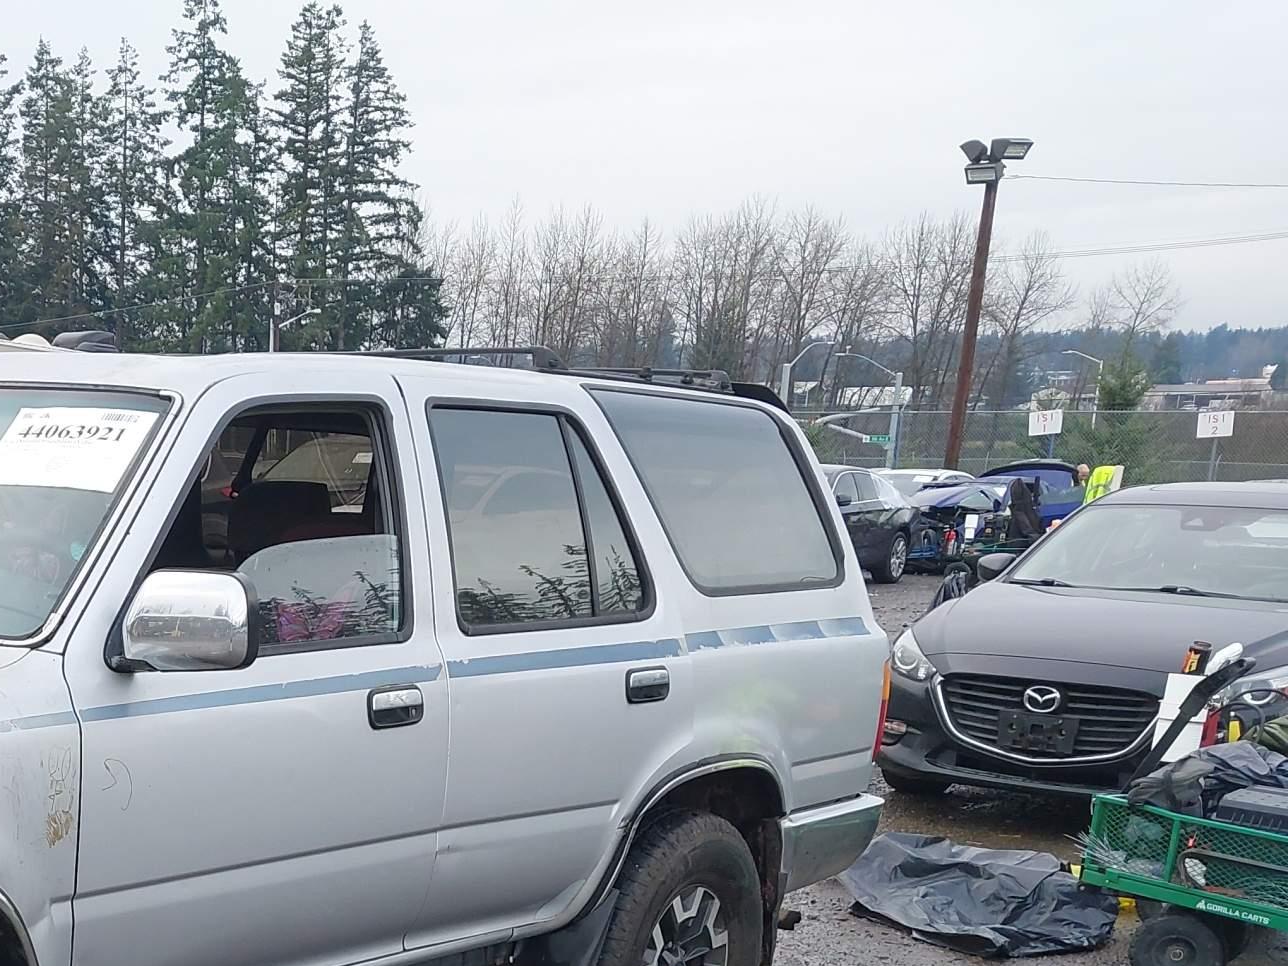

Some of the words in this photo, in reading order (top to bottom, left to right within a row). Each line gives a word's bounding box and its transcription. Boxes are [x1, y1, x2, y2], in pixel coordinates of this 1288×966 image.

[18, 424, 126, 441] 44063921
[1211, 426, 1218, 435] 2
[1206, 903, 1240, 917] GORILLA
[1241, 911, 1270, 925] CARTS
